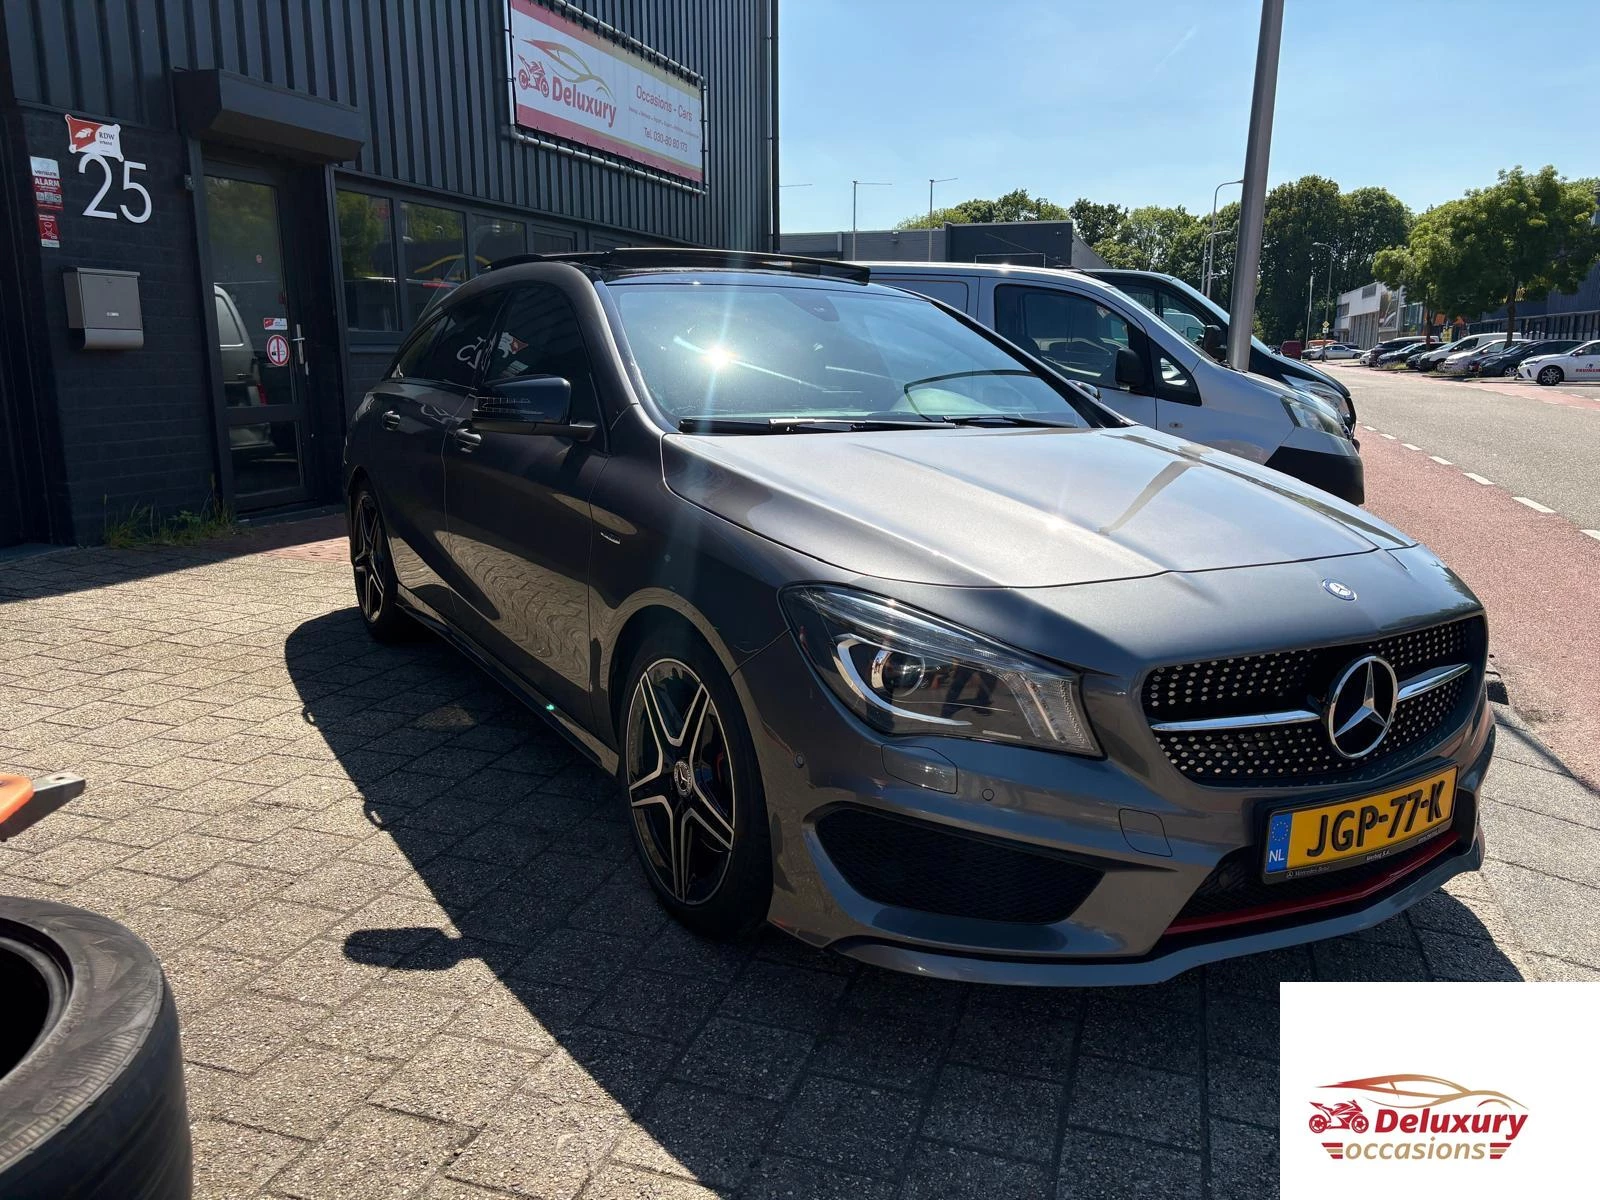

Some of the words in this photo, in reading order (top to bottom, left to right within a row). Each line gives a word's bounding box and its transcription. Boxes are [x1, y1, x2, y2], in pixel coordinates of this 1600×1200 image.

[552, 76, 617, 128] Deluxury
[636, 85, 672, 113] Occasions
[677, 105, 693, 122] Cars
[34, 177, 60, 187] ALARM
[78, 153, 152, 224] 25
[1306, 780, 1446, 857] JGP-77-K
[1268, 849, 1285, 863] NL
